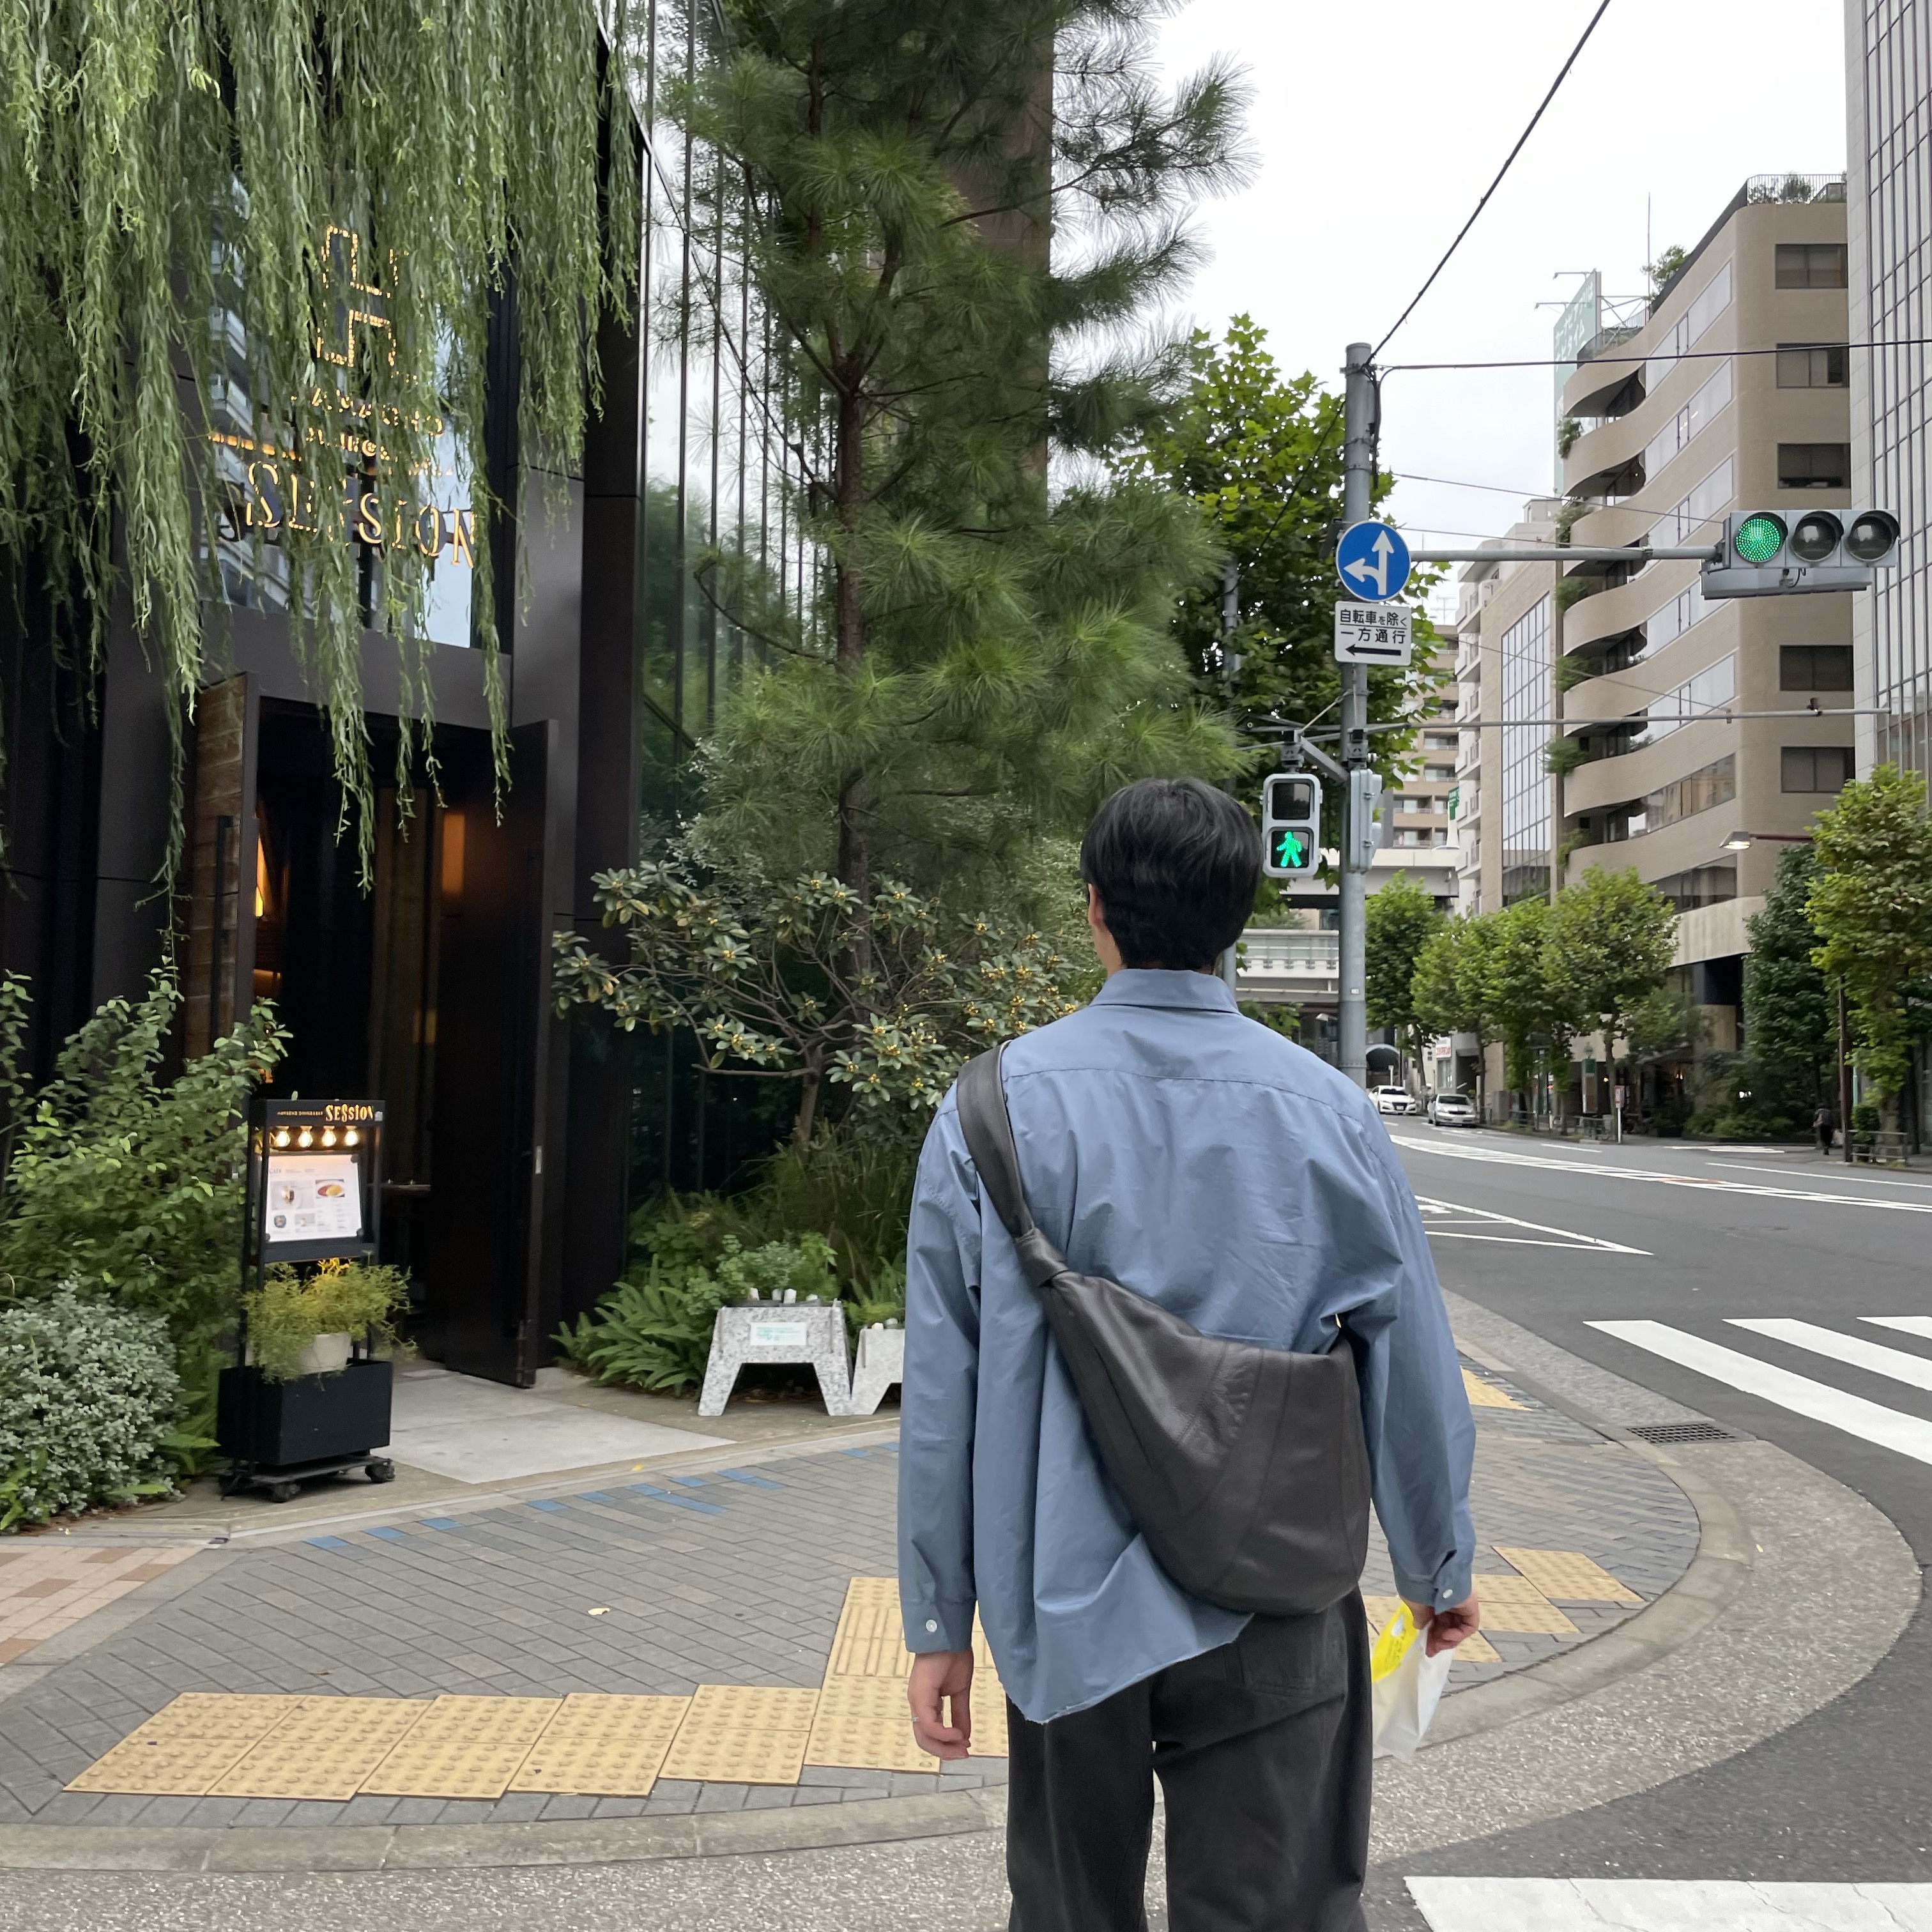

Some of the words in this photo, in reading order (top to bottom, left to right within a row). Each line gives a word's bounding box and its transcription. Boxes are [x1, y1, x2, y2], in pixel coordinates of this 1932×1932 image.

[1340, 609, 1407, 627] 自転車を除く
[1340, 627, 1406, 645] 一方通行
